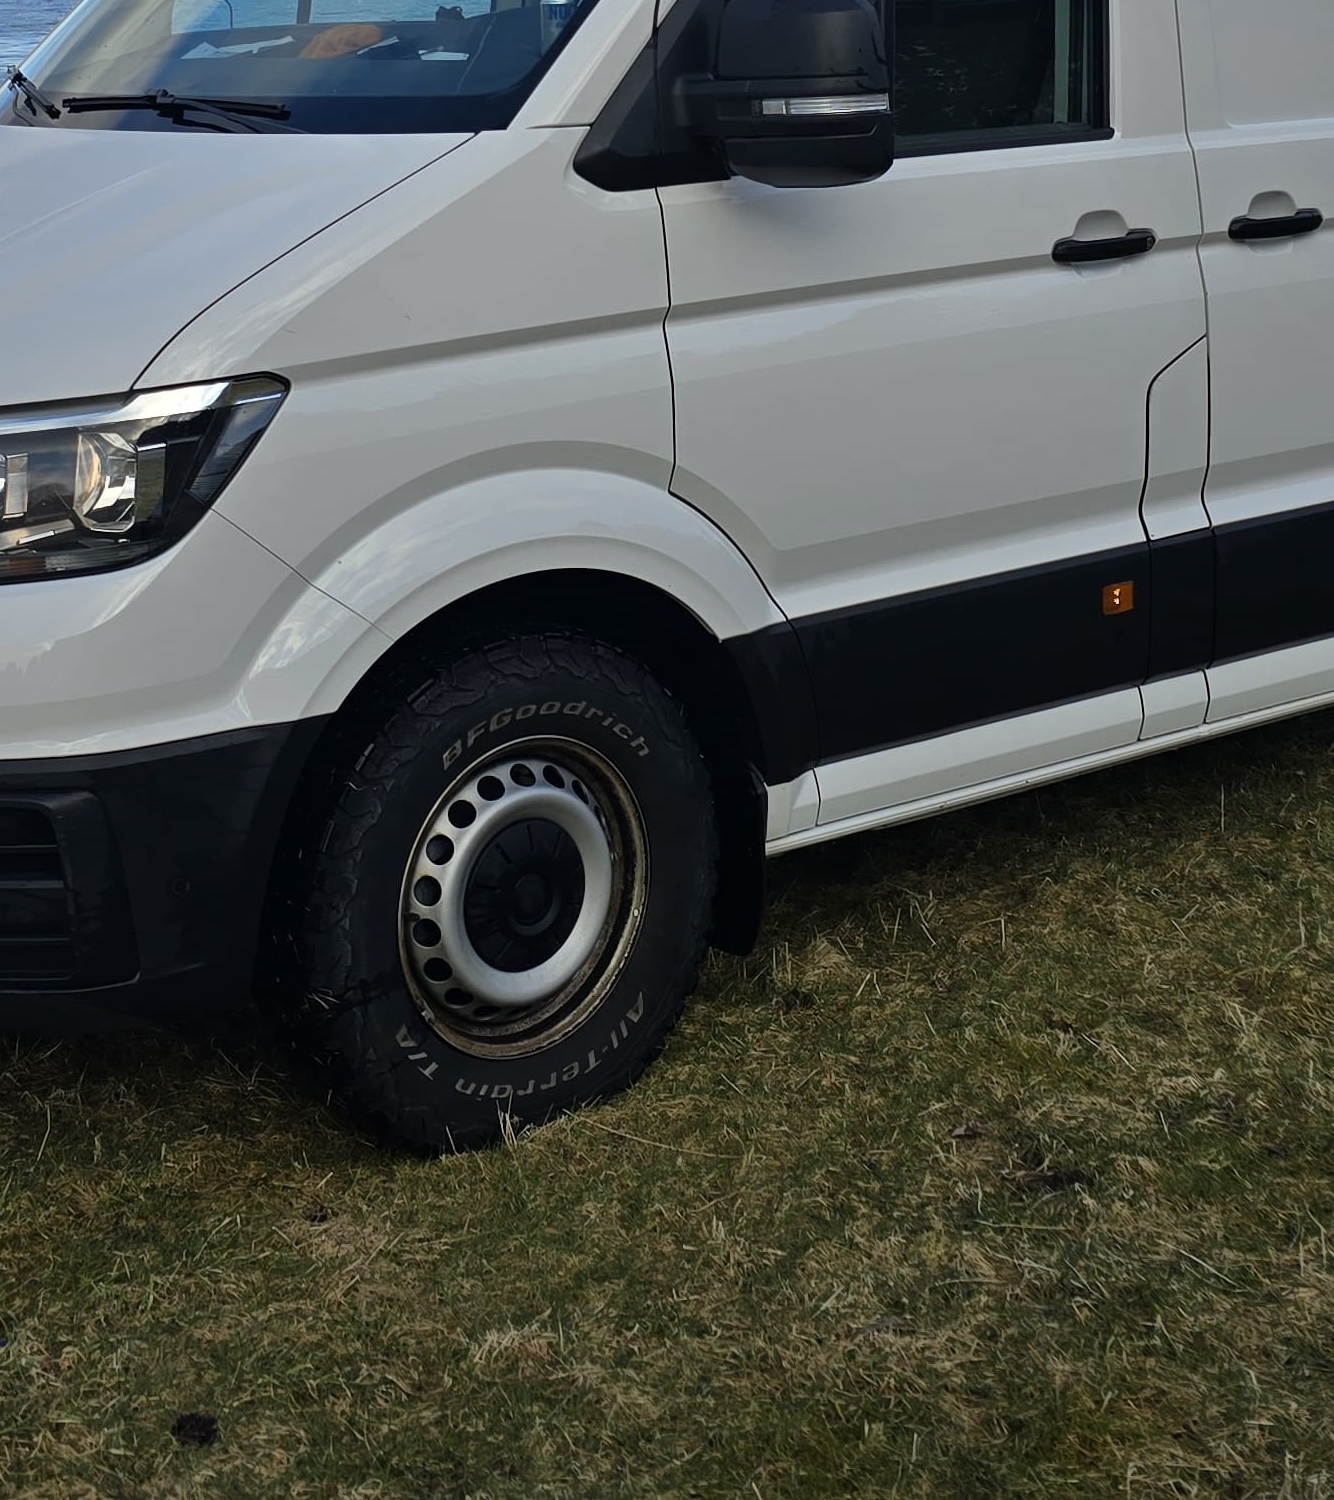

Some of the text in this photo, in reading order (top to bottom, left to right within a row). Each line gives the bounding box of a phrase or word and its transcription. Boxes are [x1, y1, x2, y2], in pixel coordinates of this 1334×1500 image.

[442, 700, 651, 771] BFGoodrich
[395, 990, 644, 1101] All-Terrain T/A
